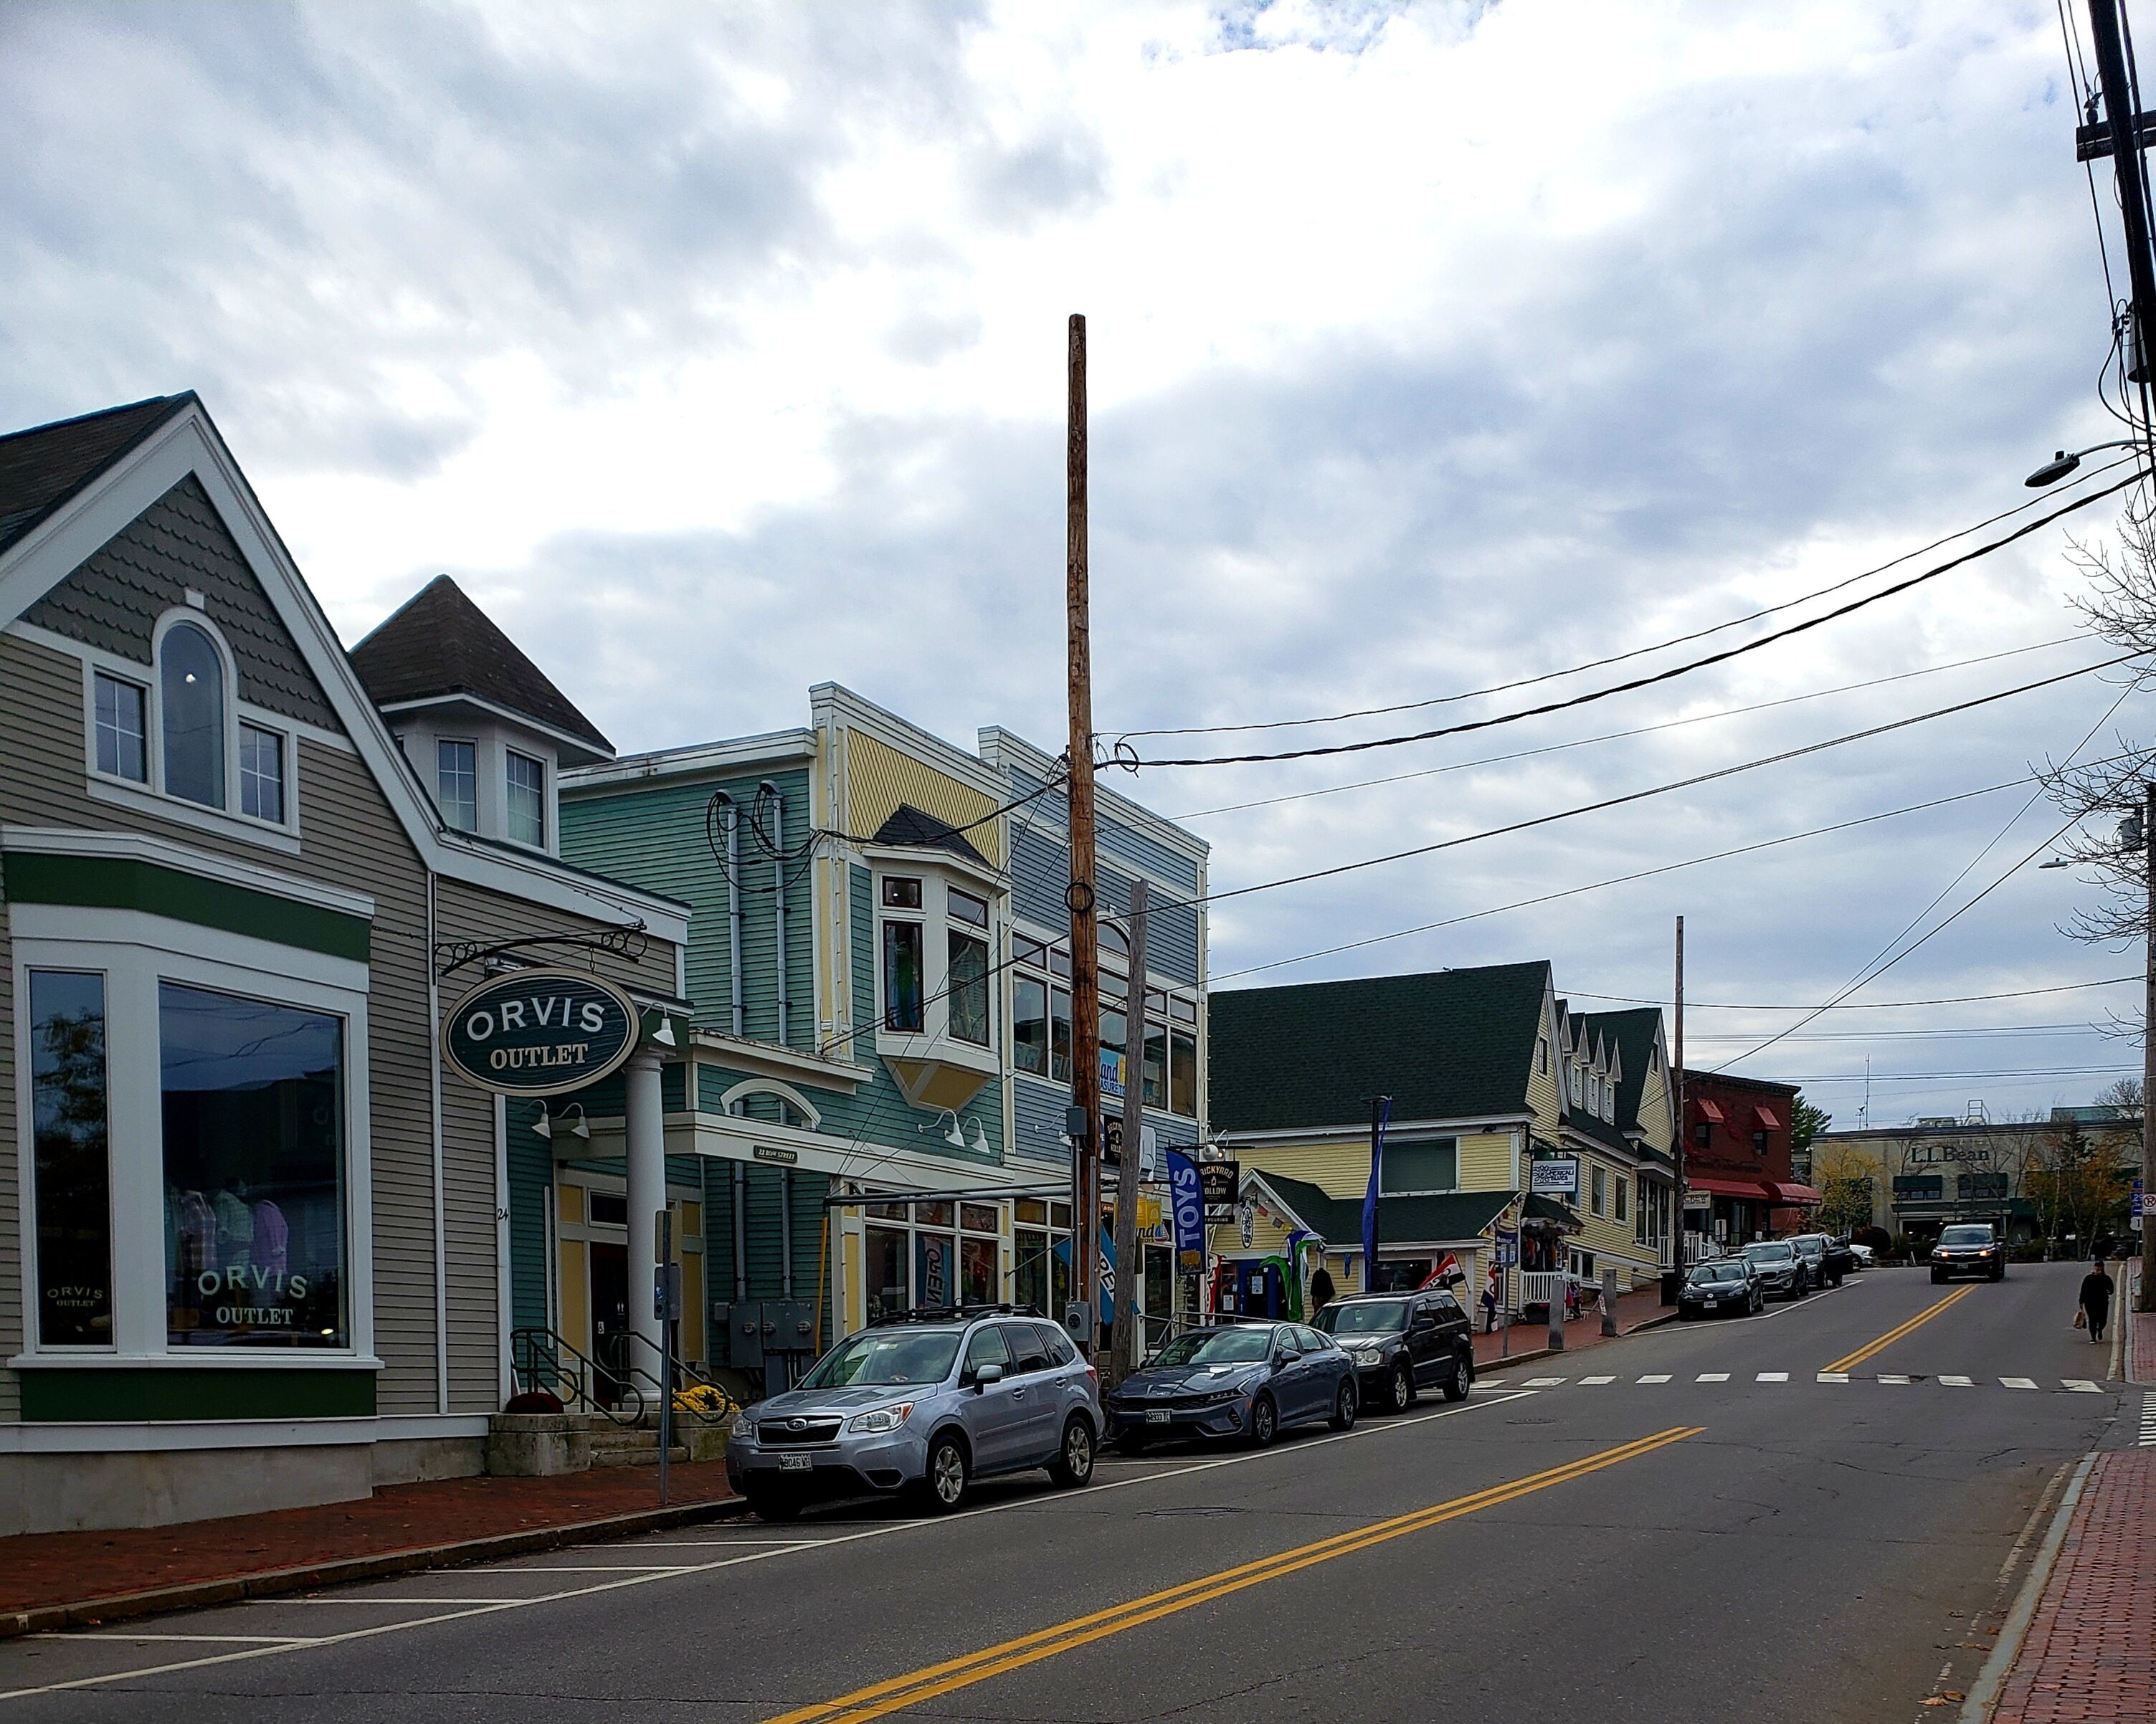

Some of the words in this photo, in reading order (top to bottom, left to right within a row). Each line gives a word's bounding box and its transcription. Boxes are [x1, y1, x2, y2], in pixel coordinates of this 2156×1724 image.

[467, 996, 605, 1041] ORVIS
[490, 1043, 589, 1070] OUTLET
[1100, 1062, 1119, 1083] and
[1911, 1146, 1990, 1163] L.L.Bean
[1200, 1165, 1234, 1178] RICKYARD
[498, 1208, 509, 1221] 24
[1174, 1167, 1201, 1248] TOYS
[198, 1264, 308, 1299] ORVIS
[926, 1248, 943, 1305] OPEN
[1100, 1257, 1116, 1294] PE
[47, 1285, 103, 1299] ORVIS
[216, 1307, 293, 1325] OUTLET
